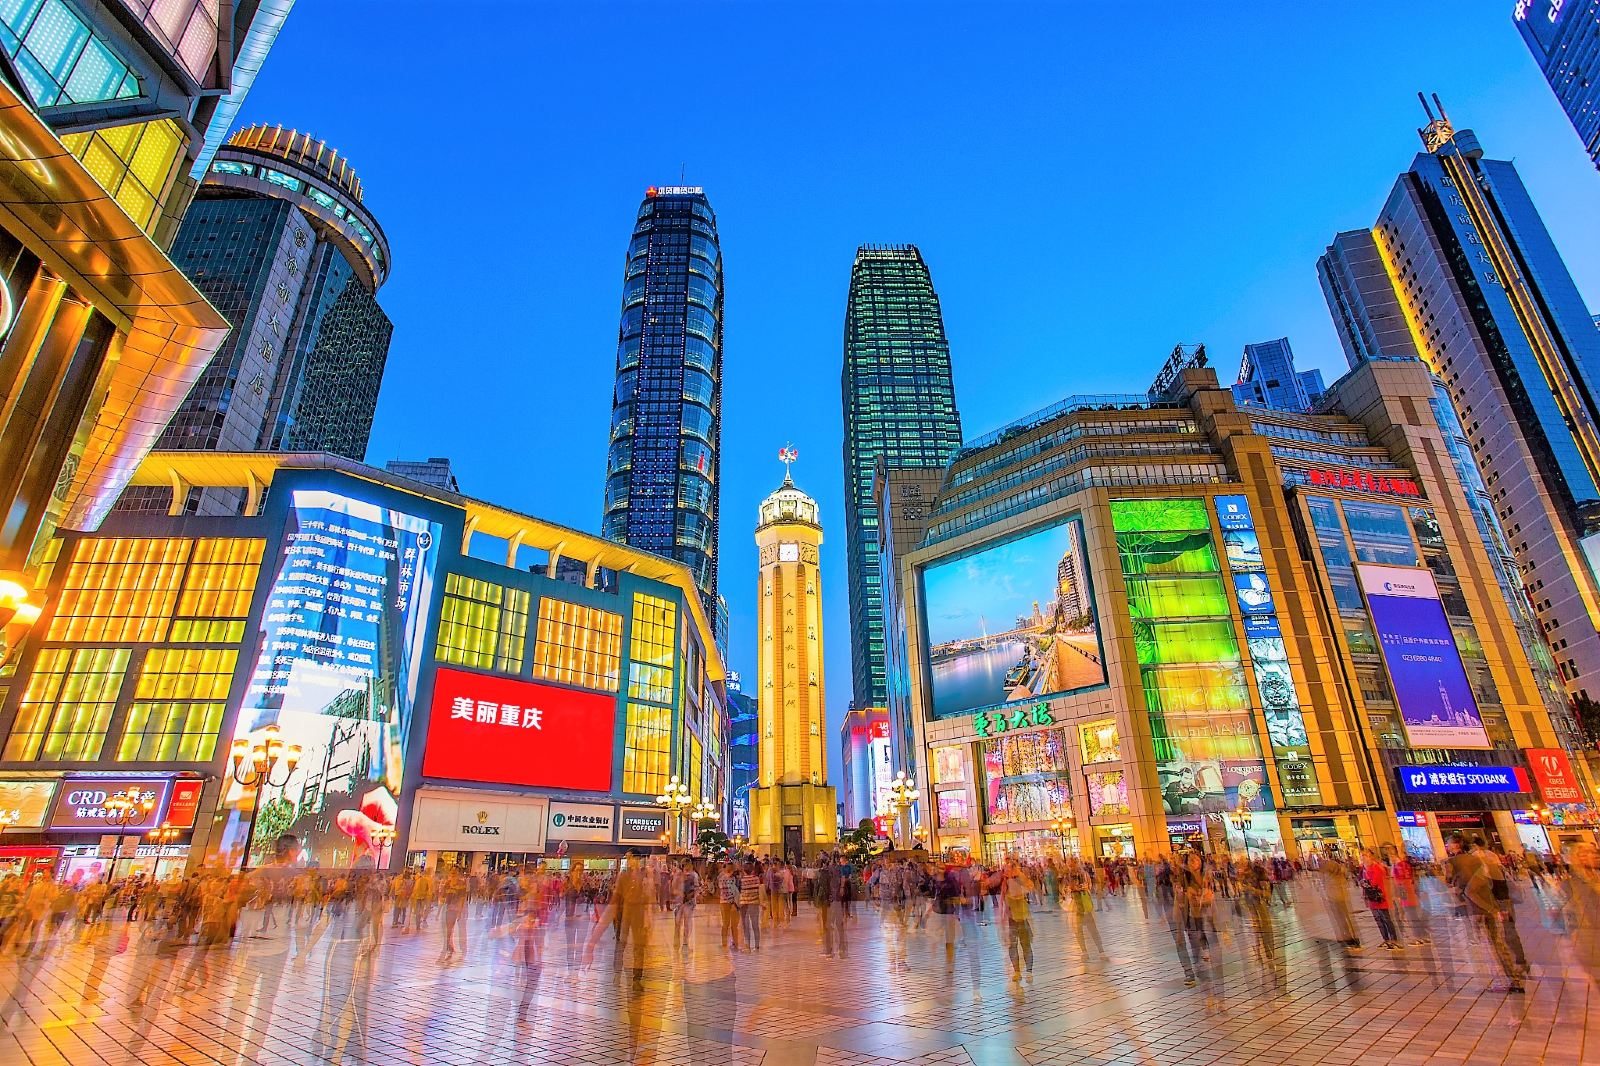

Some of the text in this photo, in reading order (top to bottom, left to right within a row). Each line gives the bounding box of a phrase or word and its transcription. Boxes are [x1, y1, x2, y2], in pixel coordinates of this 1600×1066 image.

[249, 251, 299, 396] 渝都大酒店
[395, 547, 417, 612] 群林市场
[450, 696, 544, 730] 美丽重庆
[974, 702, 1053, 737] 重百大楼
[1226, 764, 1263, 774] LONGINES
[1428, 773, 1467, 786] 浦发银行
[1485, 774, 1510, 784] BANK
[67, 790, 106, 805] CRD
[1545, 787, 1580, 800] 重百超市
[567, 814, 610, 825] 中国农业银行
[625, 818, 662, 826] STARBUCKS
[462, 825, 500, 835] ROLEX
